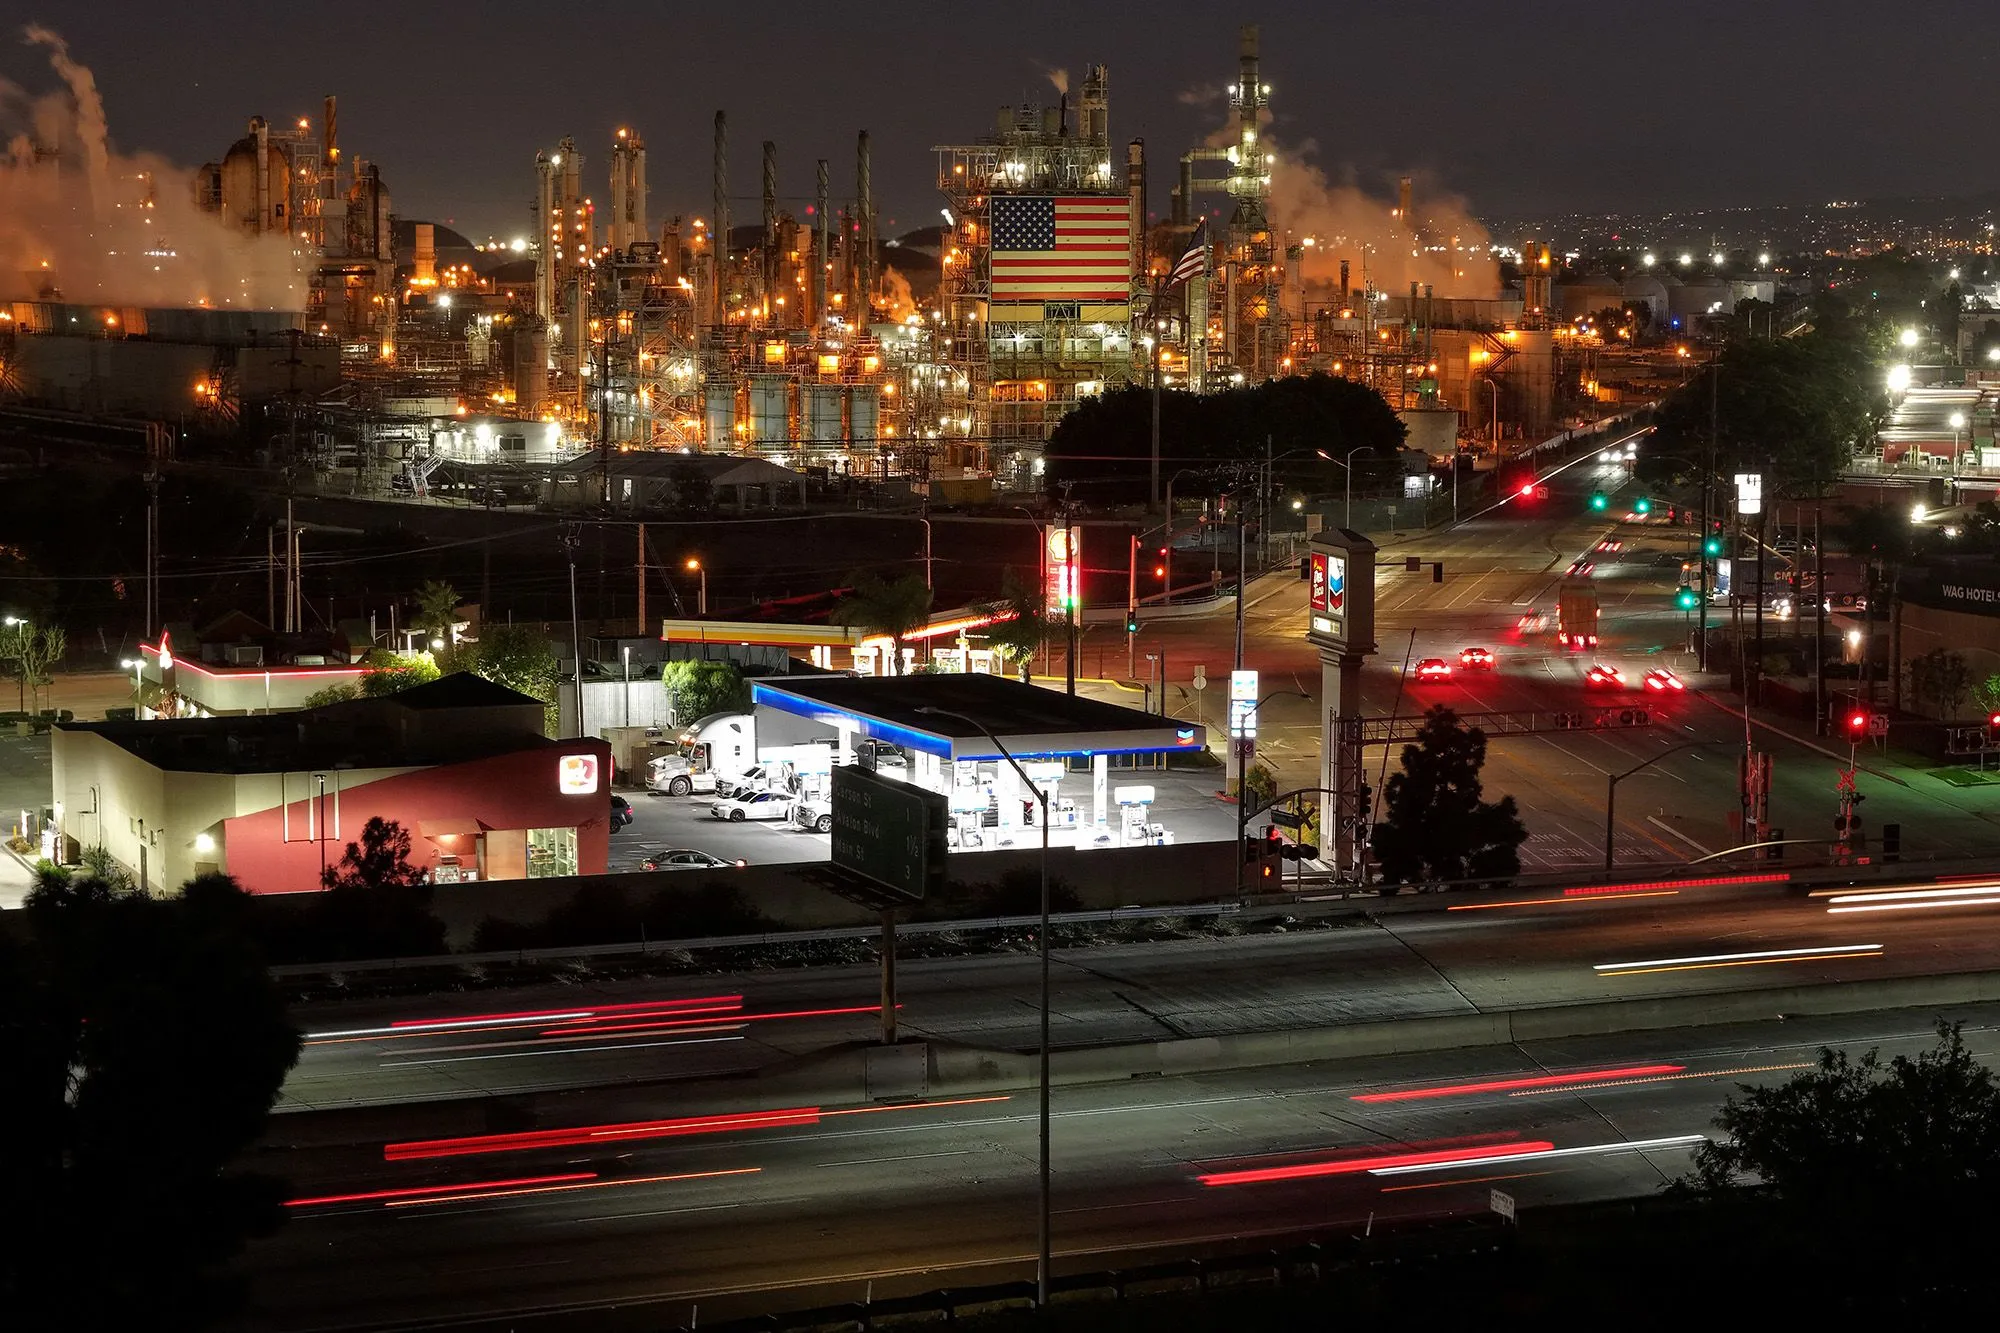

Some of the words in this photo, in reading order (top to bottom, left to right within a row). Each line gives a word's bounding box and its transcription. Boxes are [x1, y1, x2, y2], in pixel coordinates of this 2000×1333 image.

[1942, 584, 1965, 599] WAG
[836, 782, 861, 804] Carson
[864, 792, 872, 808] St
[837, 810, 861, 832] Avalon
[864, 820, 880, 840] Blvd
[836, 837, 854, 857] Main
[856, 844, 864, 861] St
[905, 865, 911, 880] 3
